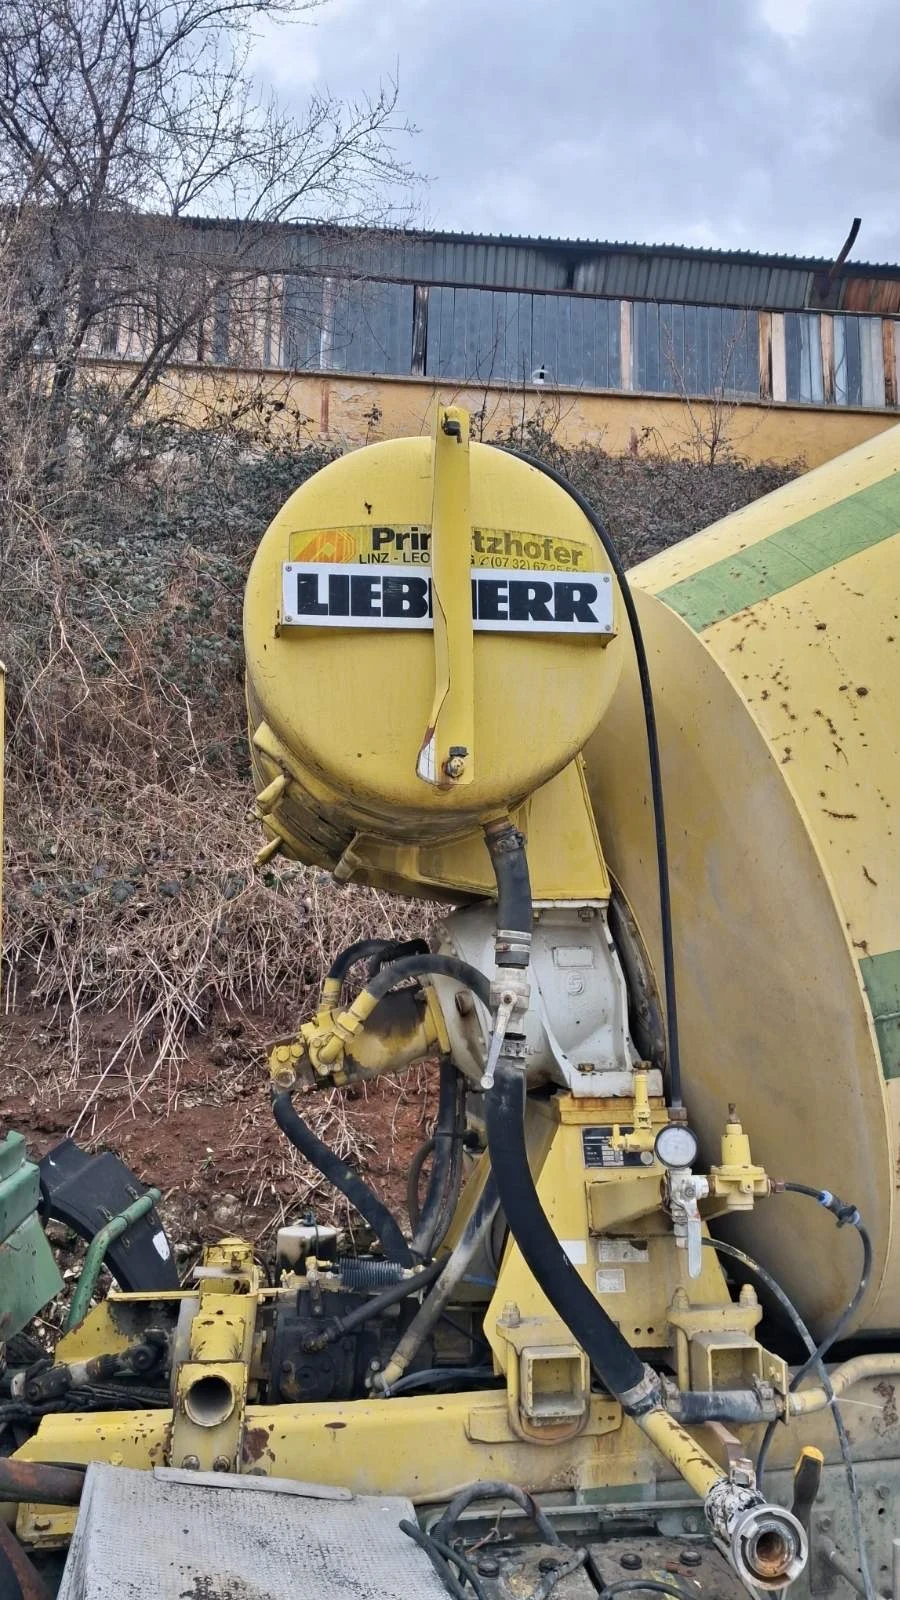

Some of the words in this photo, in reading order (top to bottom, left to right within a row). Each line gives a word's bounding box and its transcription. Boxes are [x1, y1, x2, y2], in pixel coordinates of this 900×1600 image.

[359, 552, 390, 565] LINZ
[490, 556, 509, 569] (07
[512, 559, 530, 571] 32)
[372, 526, 583, 566] Pritzhofer
[297, 573, 599, 623] LIEBERR
